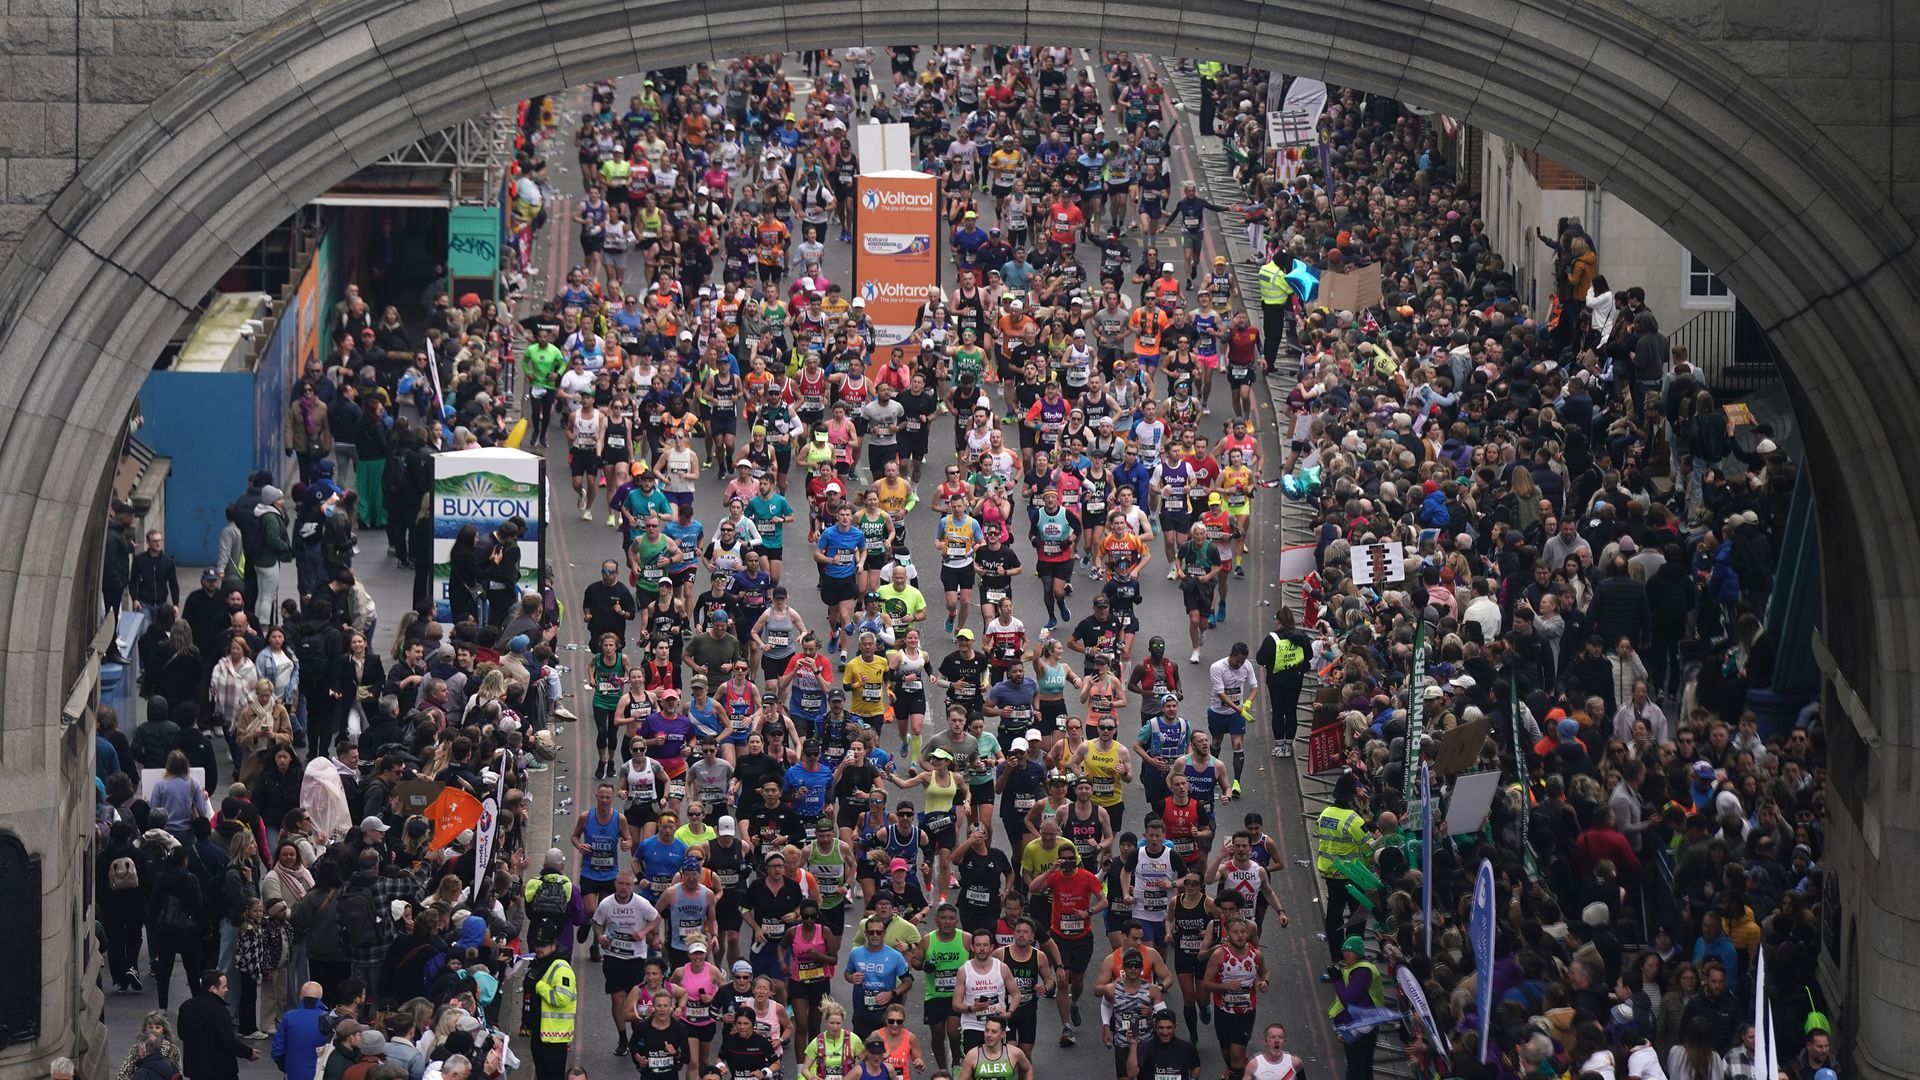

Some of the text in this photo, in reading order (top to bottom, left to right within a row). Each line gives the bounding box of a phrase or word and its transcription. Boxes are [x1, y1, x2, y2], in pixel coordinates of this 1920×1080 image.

[879, 191, 933, 205] Voltarol
[878, 283, 932, 297] Voltarol
[1044, 411, 1063, 419] Stroke
[1164, 475, 1185, 484] Stroke
[443, 499, 530, 518] BUXTON
[1111, 542, 1130, 550] JACK
[982, 559, 1004, 568] Taylor
[1045, 676, 1065, 685] JADE
[1411, 647, 1426, 750] RUNNERS
[1404, 739, 1412, 766] London
[1091, 755, 1114, 763] Meego
[1320, 819, 1337, 829] POLICE
[1073, 826, 1095, 835] ROB
[592, 841, 612, 851] RICKY
[1233, 872, 1256, 880] HUGH
[1177, 918, 1205, 926] VERSUS
[979, 1062, 1008, 1074] ALEX
